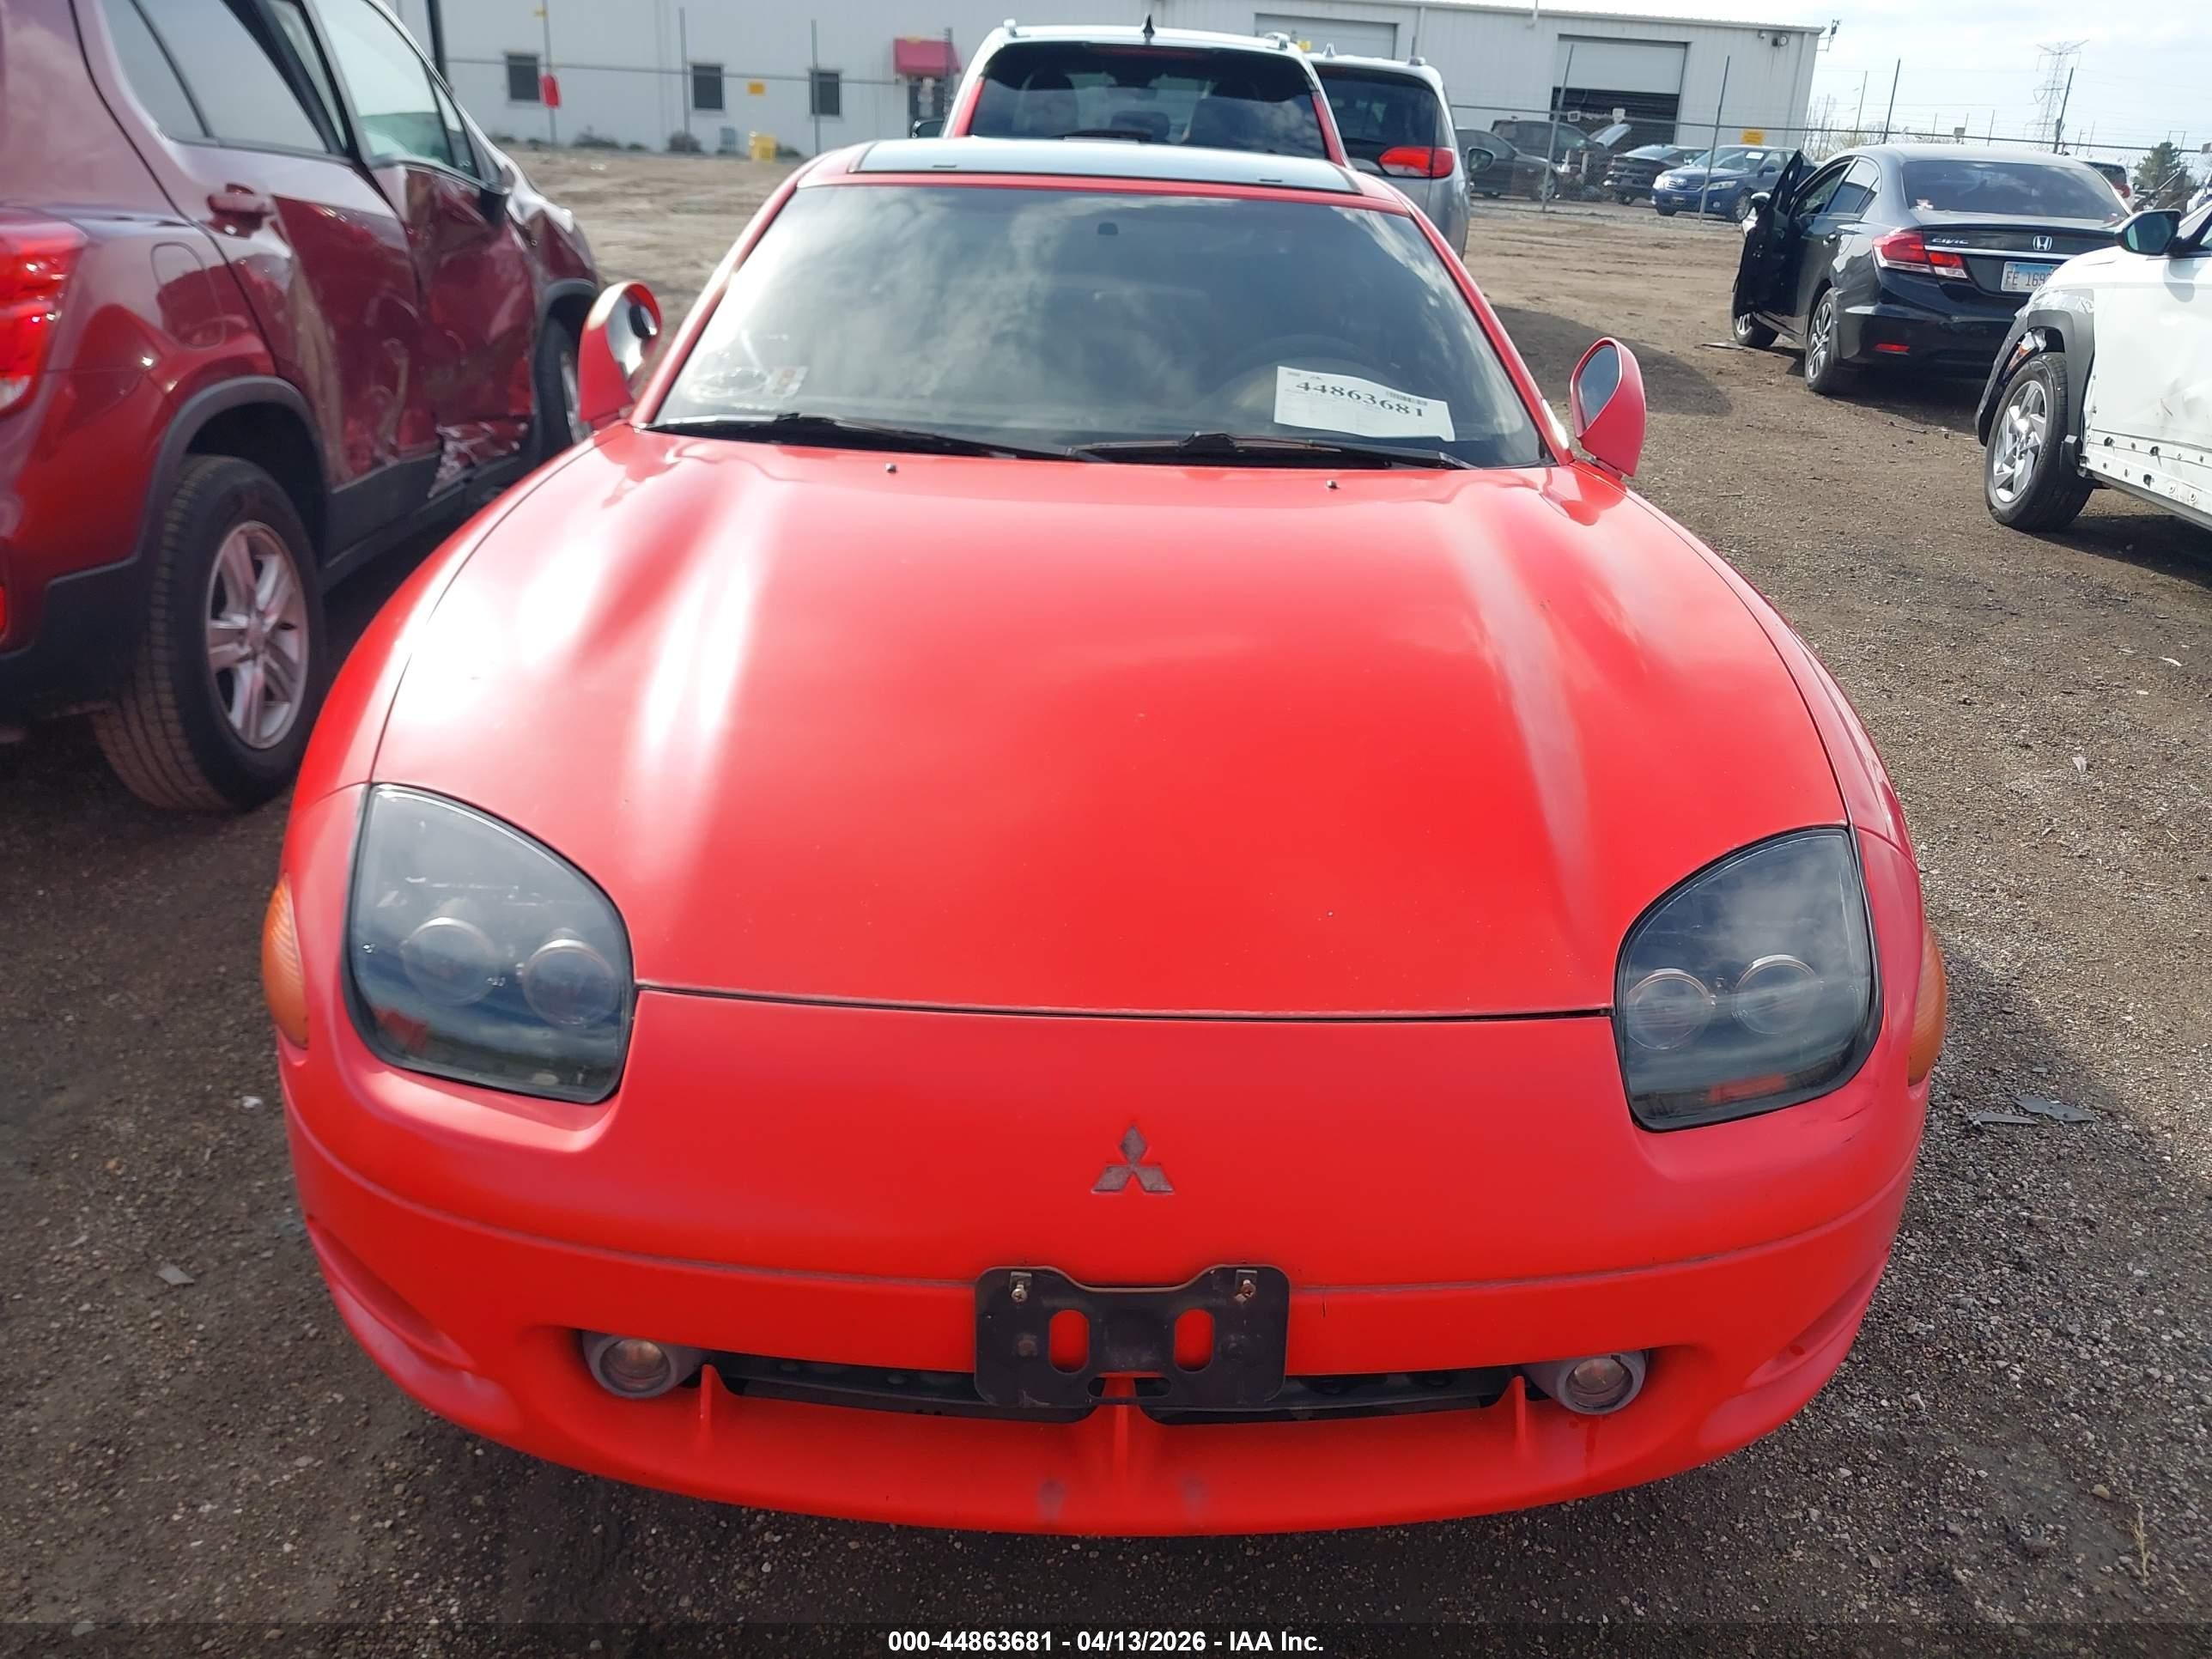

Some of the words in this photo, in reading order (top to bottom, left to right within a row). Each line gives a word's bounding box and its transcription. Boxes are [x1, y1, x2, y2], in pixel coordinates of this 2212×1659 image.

[2005, 270, 2020, 286] FE
[2025, 271, 2052, 287] 169
[1296, 381, 1424, 417] 44863681
